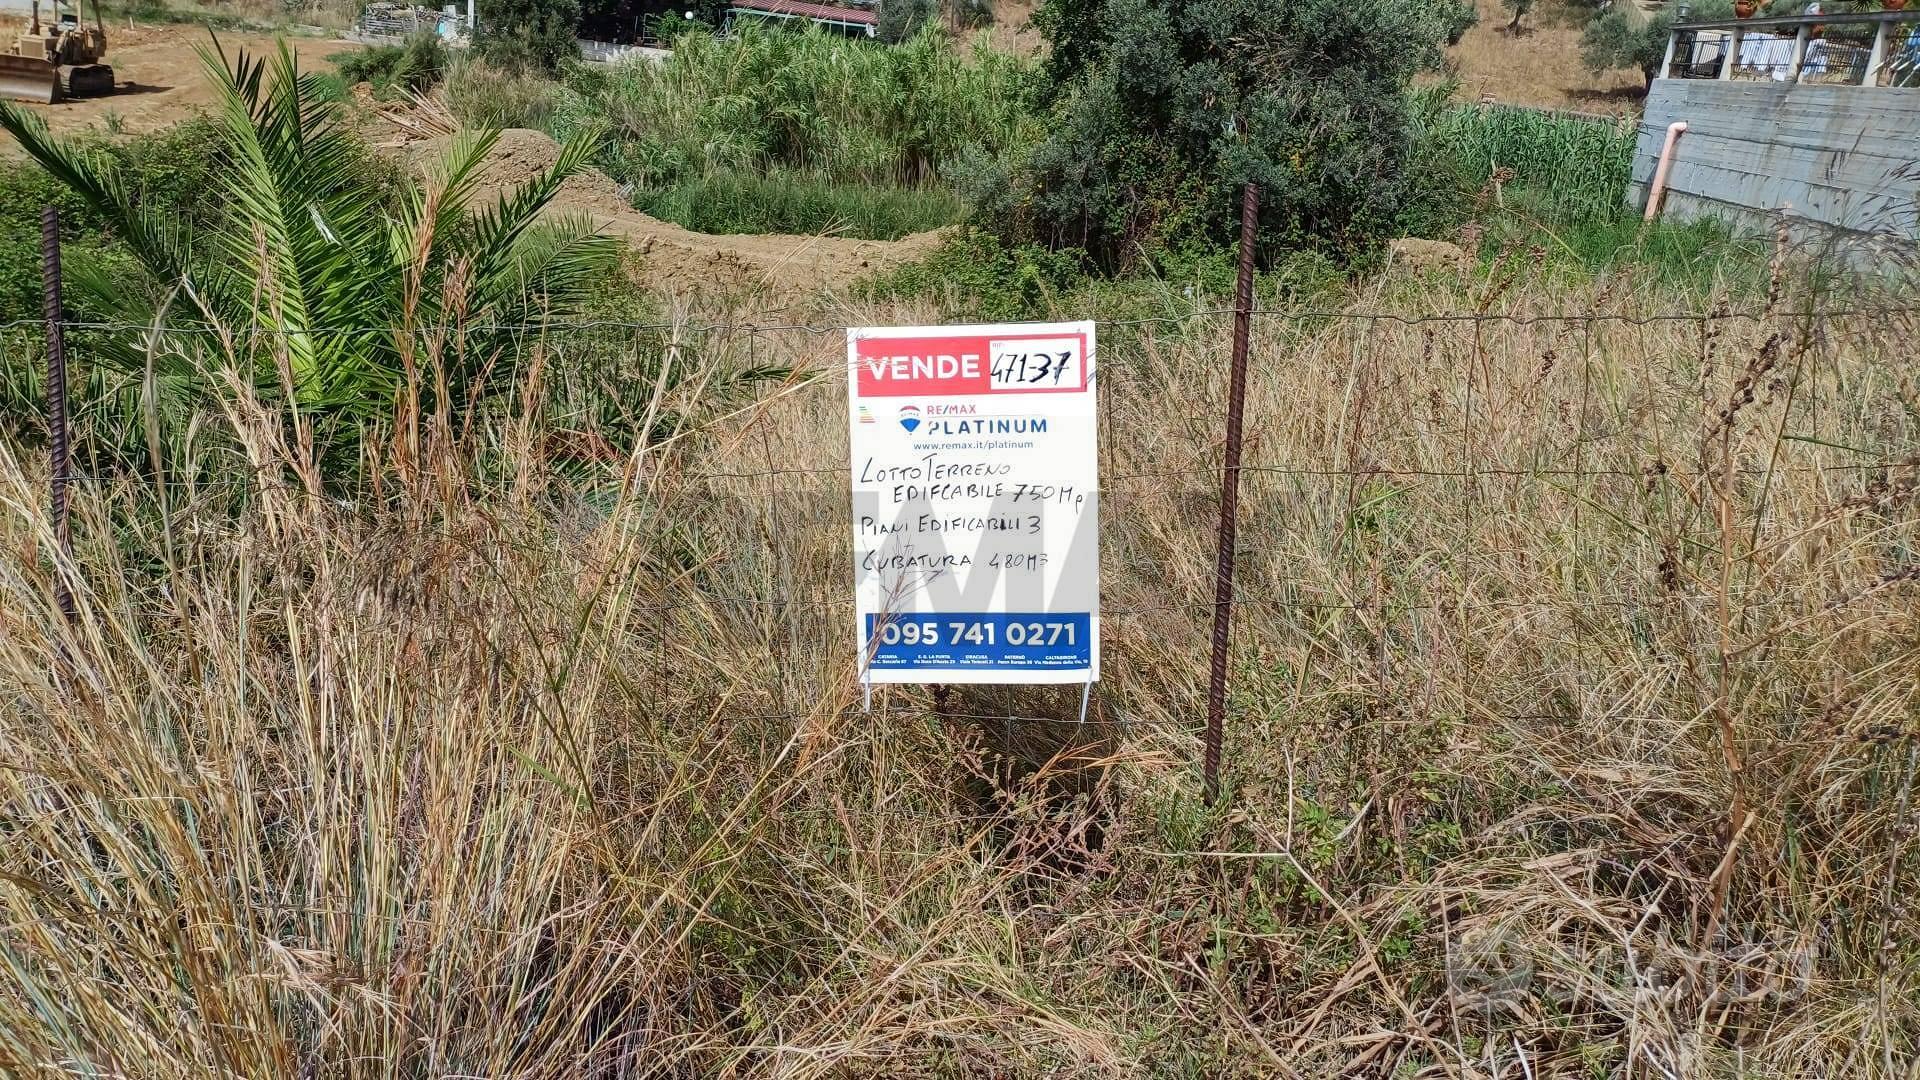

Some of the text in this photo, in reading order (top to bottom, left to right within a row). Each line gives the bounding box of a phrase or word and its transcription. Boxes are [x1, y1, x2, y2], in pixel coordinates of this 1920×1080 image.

[866, 354, 980, 380] VENDE
[927, 405, 977, 415] RE/MAX
[928, 419, 1048, 434] PLATINUM
[913, 440, 1034, 450] www.remax.it/platinum
[861, 453, 1011, 483] LOTTO TERRENO
[861, 516, 908, 535] PIANI
[1028, 515, 1041, 534] 3
[862, 550, 972, 572] CUBATURA
[882, 622, 1076, 645] 095 741 0271
